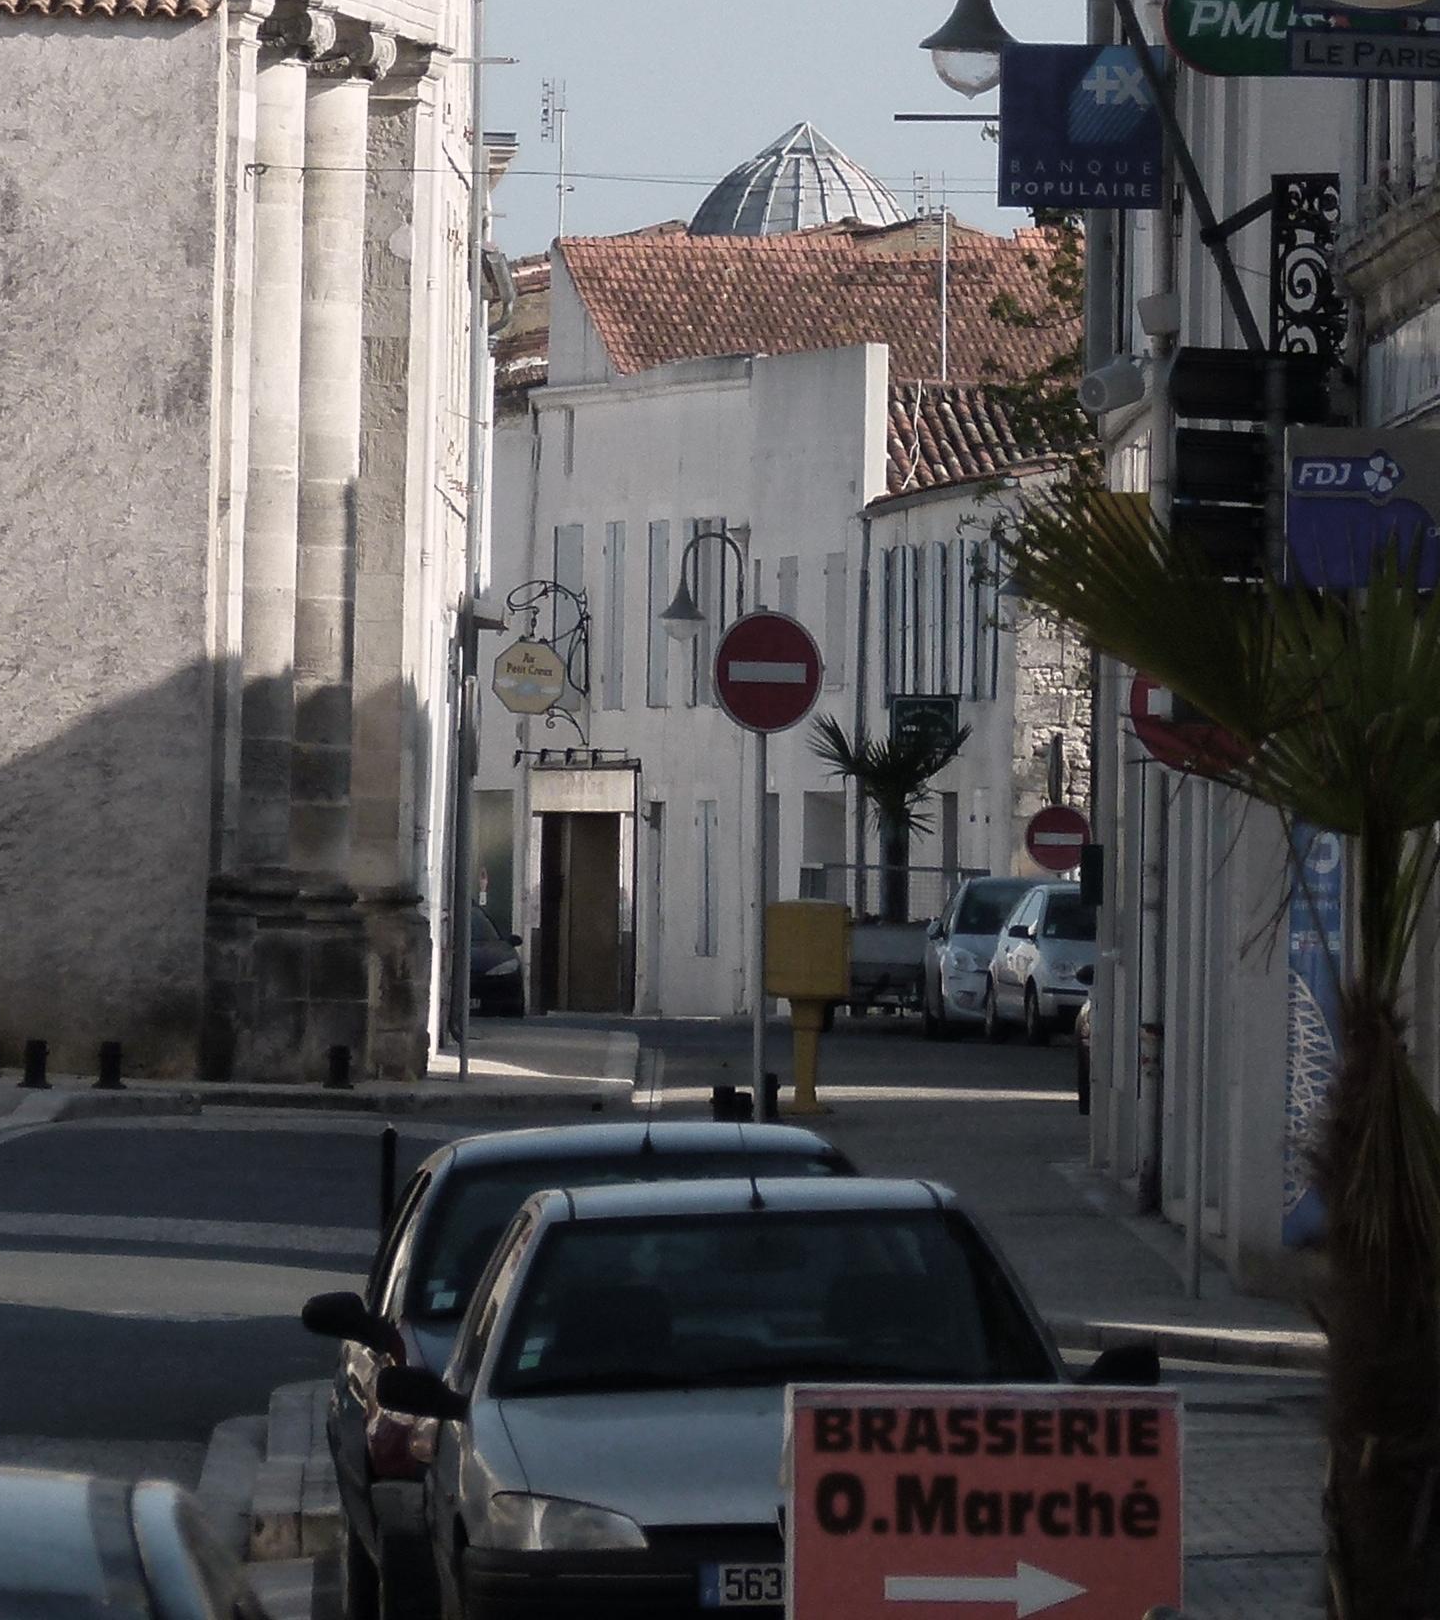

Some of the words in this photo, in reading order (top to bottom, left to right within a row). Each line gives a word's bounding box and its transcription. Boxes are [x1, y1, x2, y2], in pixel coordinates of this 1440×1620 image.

[1188, 0, 1294, 39] PMU
[1010, 159, 1152, 177] BANQUE
[1011, 181, 1152, 197] POPULAIRE
[1299, 463, 1351, 485] FDJ
[813, 1406, 1160, 1458] BRASSERIE
[815, 1472, 1160, 1538] O.Marché
[724, 1567, 783, 1600] 563
